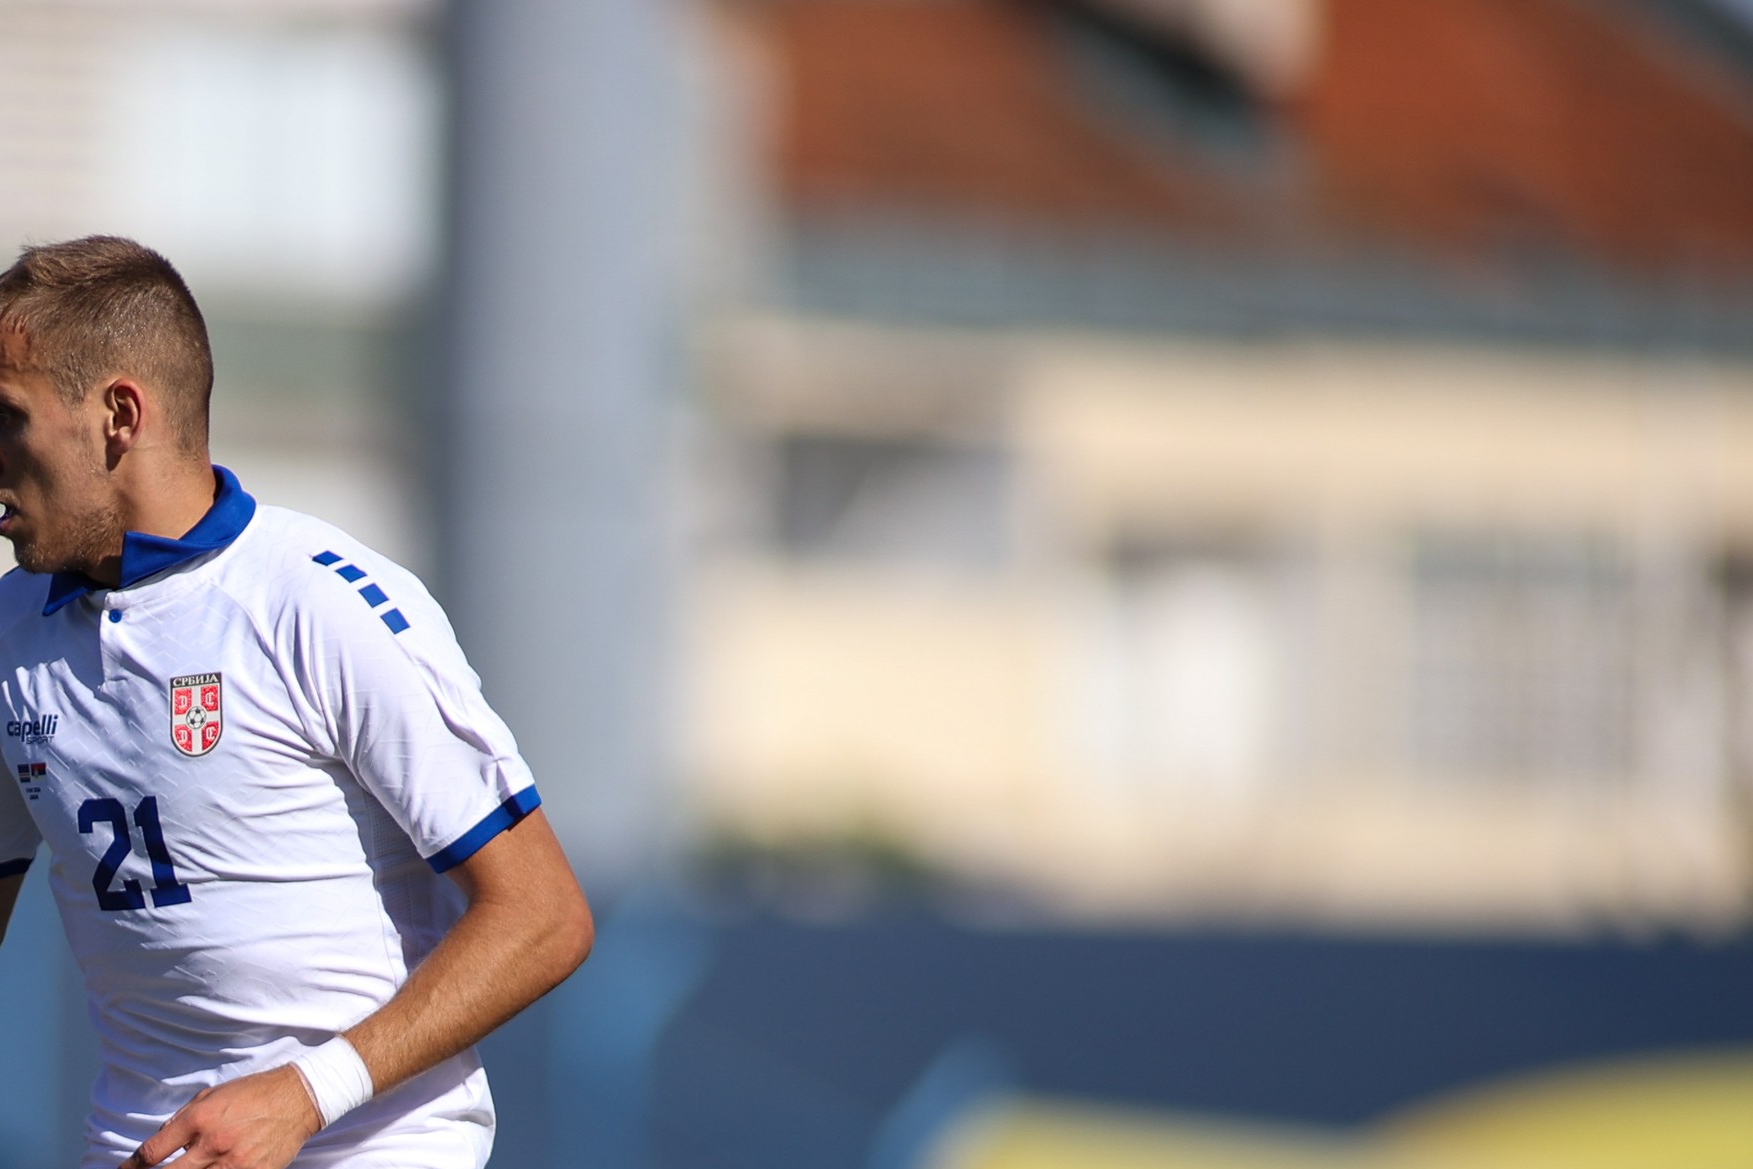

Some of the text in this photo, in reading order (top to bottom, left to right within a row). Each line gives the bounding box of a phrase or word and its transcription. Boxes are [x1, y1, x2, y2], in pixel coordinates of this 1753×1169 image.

[172, 673, 219, 687] СРБИЈА
[6, 714, 58, 742] capelli
[25, 735, 55, 745] SPORT
[77, 795, 192, 911] 21
